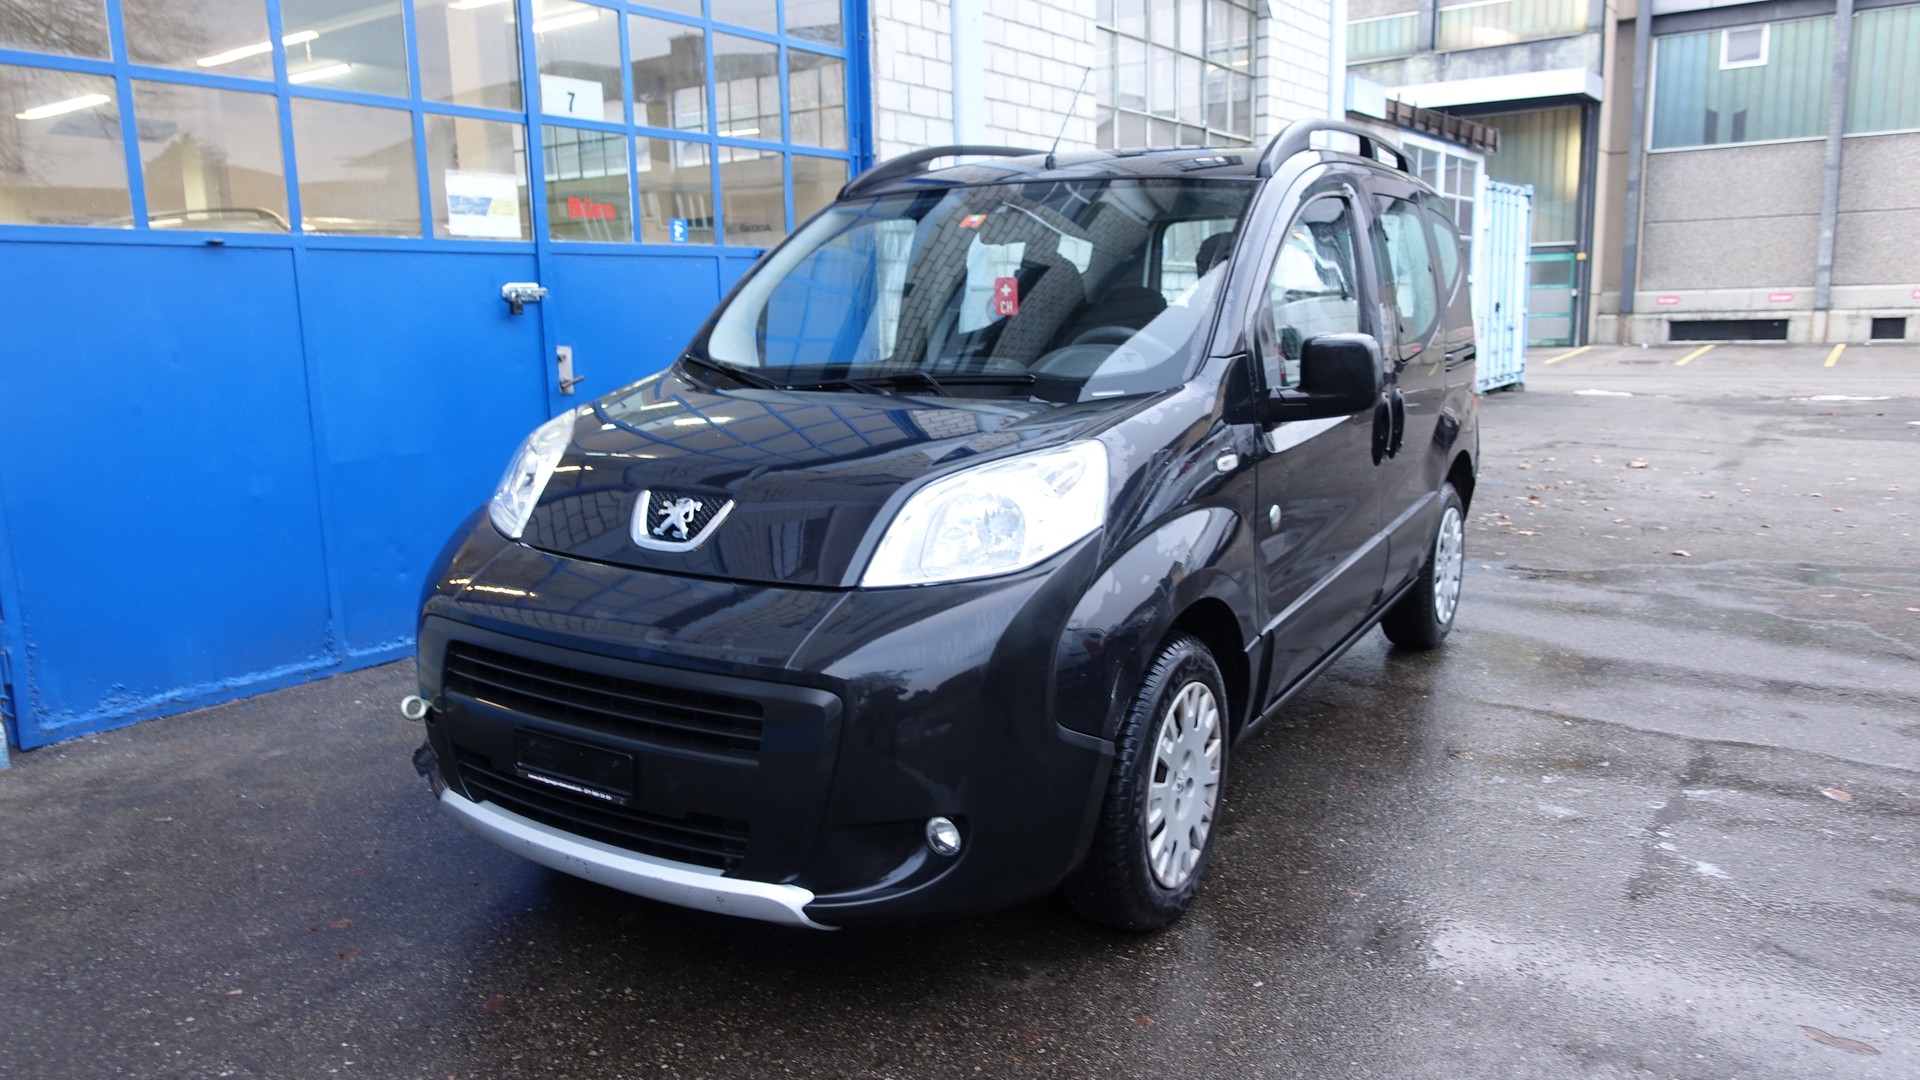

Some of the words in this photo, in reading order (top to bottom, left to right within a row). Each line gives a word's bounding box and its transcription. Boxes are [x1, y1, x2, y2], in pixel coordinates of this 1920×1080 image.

[567, 91, 575, 112] 7
[567, 196, 616, 220] Büro
[1000, 301, 1013, 313] CH
